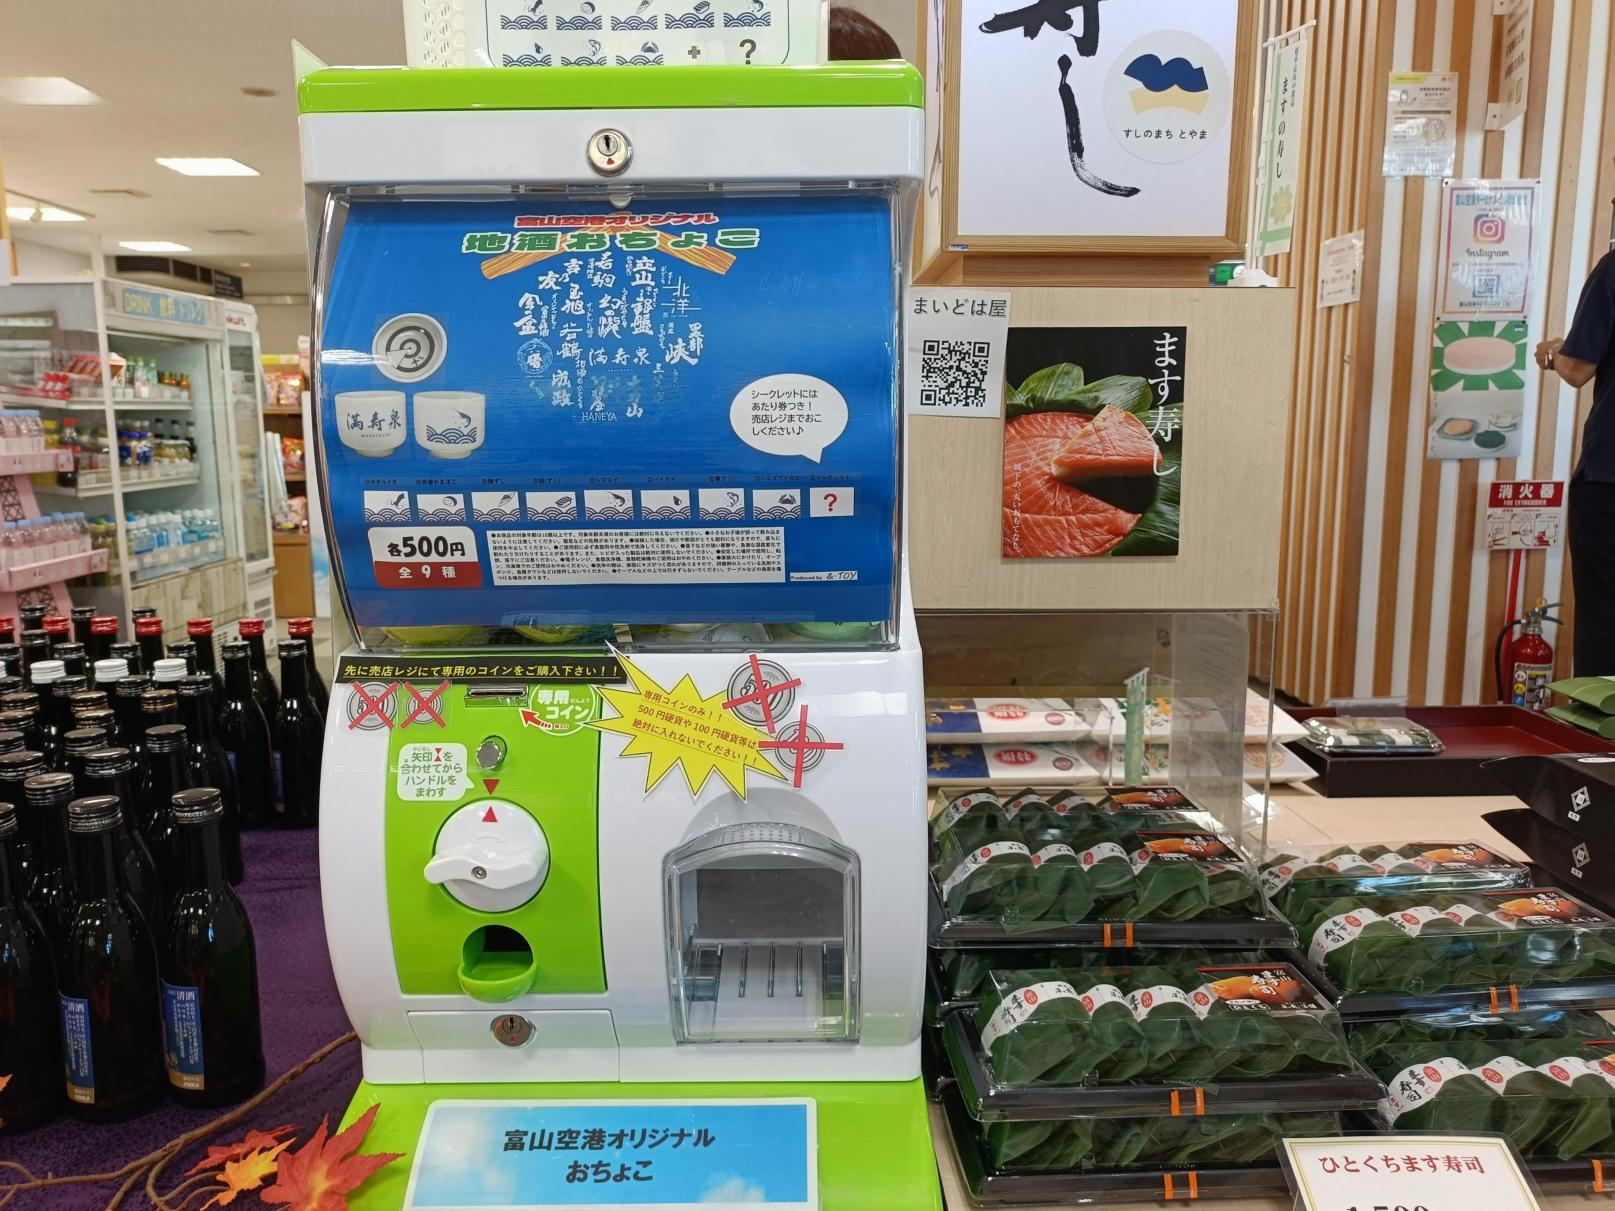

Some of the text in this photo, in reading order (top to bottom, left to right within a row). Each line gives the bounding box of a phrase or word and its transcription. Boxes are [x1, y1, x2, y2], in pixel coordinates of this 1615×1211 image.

[739, 38, 757, 65] ?
[1123, 128, 1208, 140] すしのまち とやま
[514, 212, 719, 228] 富山空港オリジナル
[461, 228, 760, 254] 地酒おちょこ
[1465, 248, 1510, 260] Instagram
[630, 255, 657, 287] 立山
[661, 275, 701, 315] 北洋
[913, 297, 1007, 317] まいどは屋
[751, 389, 818, 399] シークレットには
[751, 402, 812, 411] あたり券つき！
[1147, 332, 1183, 476] ます寿し
[581, 412, 617, 422] HANEYA
[751, 414, 822, 424] 売店レジまでおこ
[1498, 483, 1554, 499] 消火器
[823, 493, 838, 512] ?
[387, 535, 466, 557] 各500円
[344, 664, 619, 677] 先に売店レジにて専用のコインをご購入下さい！！
[537, 689, 570, 704] 専用
[545, 704, 590, 720] コイン
[643, 690, 722, 722] 専用コインのみ！！
[632, 718, 757, 765] 絶対に入れないでください！！
[411, 751, 453, 762] 矢印 を
[400, 762, 463, 775] 合わせてから
[405, 774, 457, 786] ハンドルを
[415, 787, 447, 798] まわす
[502, 1127, 716, 1152] 富山空港オリジナル
[566, 1159, 654, 1184] おちょこ
[1318, 1155, 1485, 1175] ひとくちます寿司
